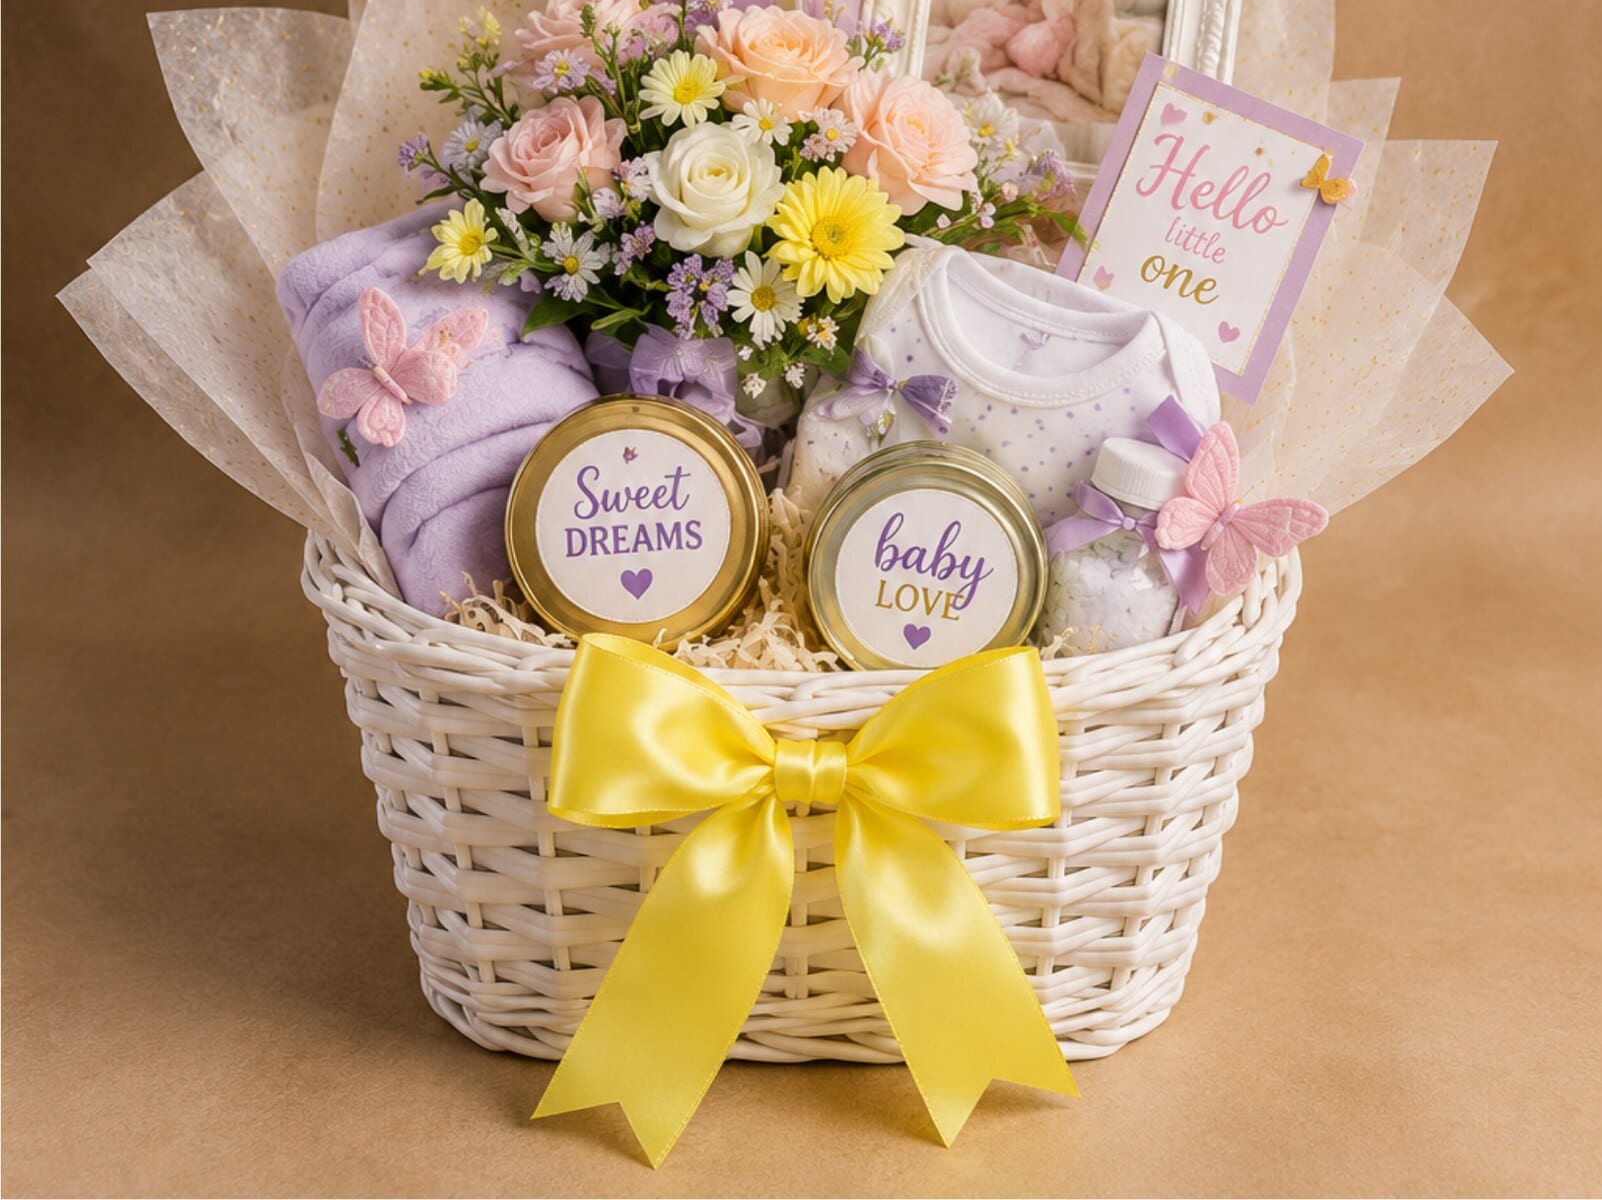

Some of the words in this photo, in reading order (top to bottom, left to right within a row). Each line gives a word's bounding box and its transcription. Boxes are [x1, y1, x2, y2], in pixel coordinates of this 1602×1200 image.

[1135, 133, 1289, 235] Hello
[1164, 215, 1226, 264] little
[1139, 255, 1220, 305] one
[573, 465, 691, 520] Sweet
[564, 519, 704, 558] DREAMS
[874, 512, 995, 611] baby
[874, 579, 966, 621] LOVE
